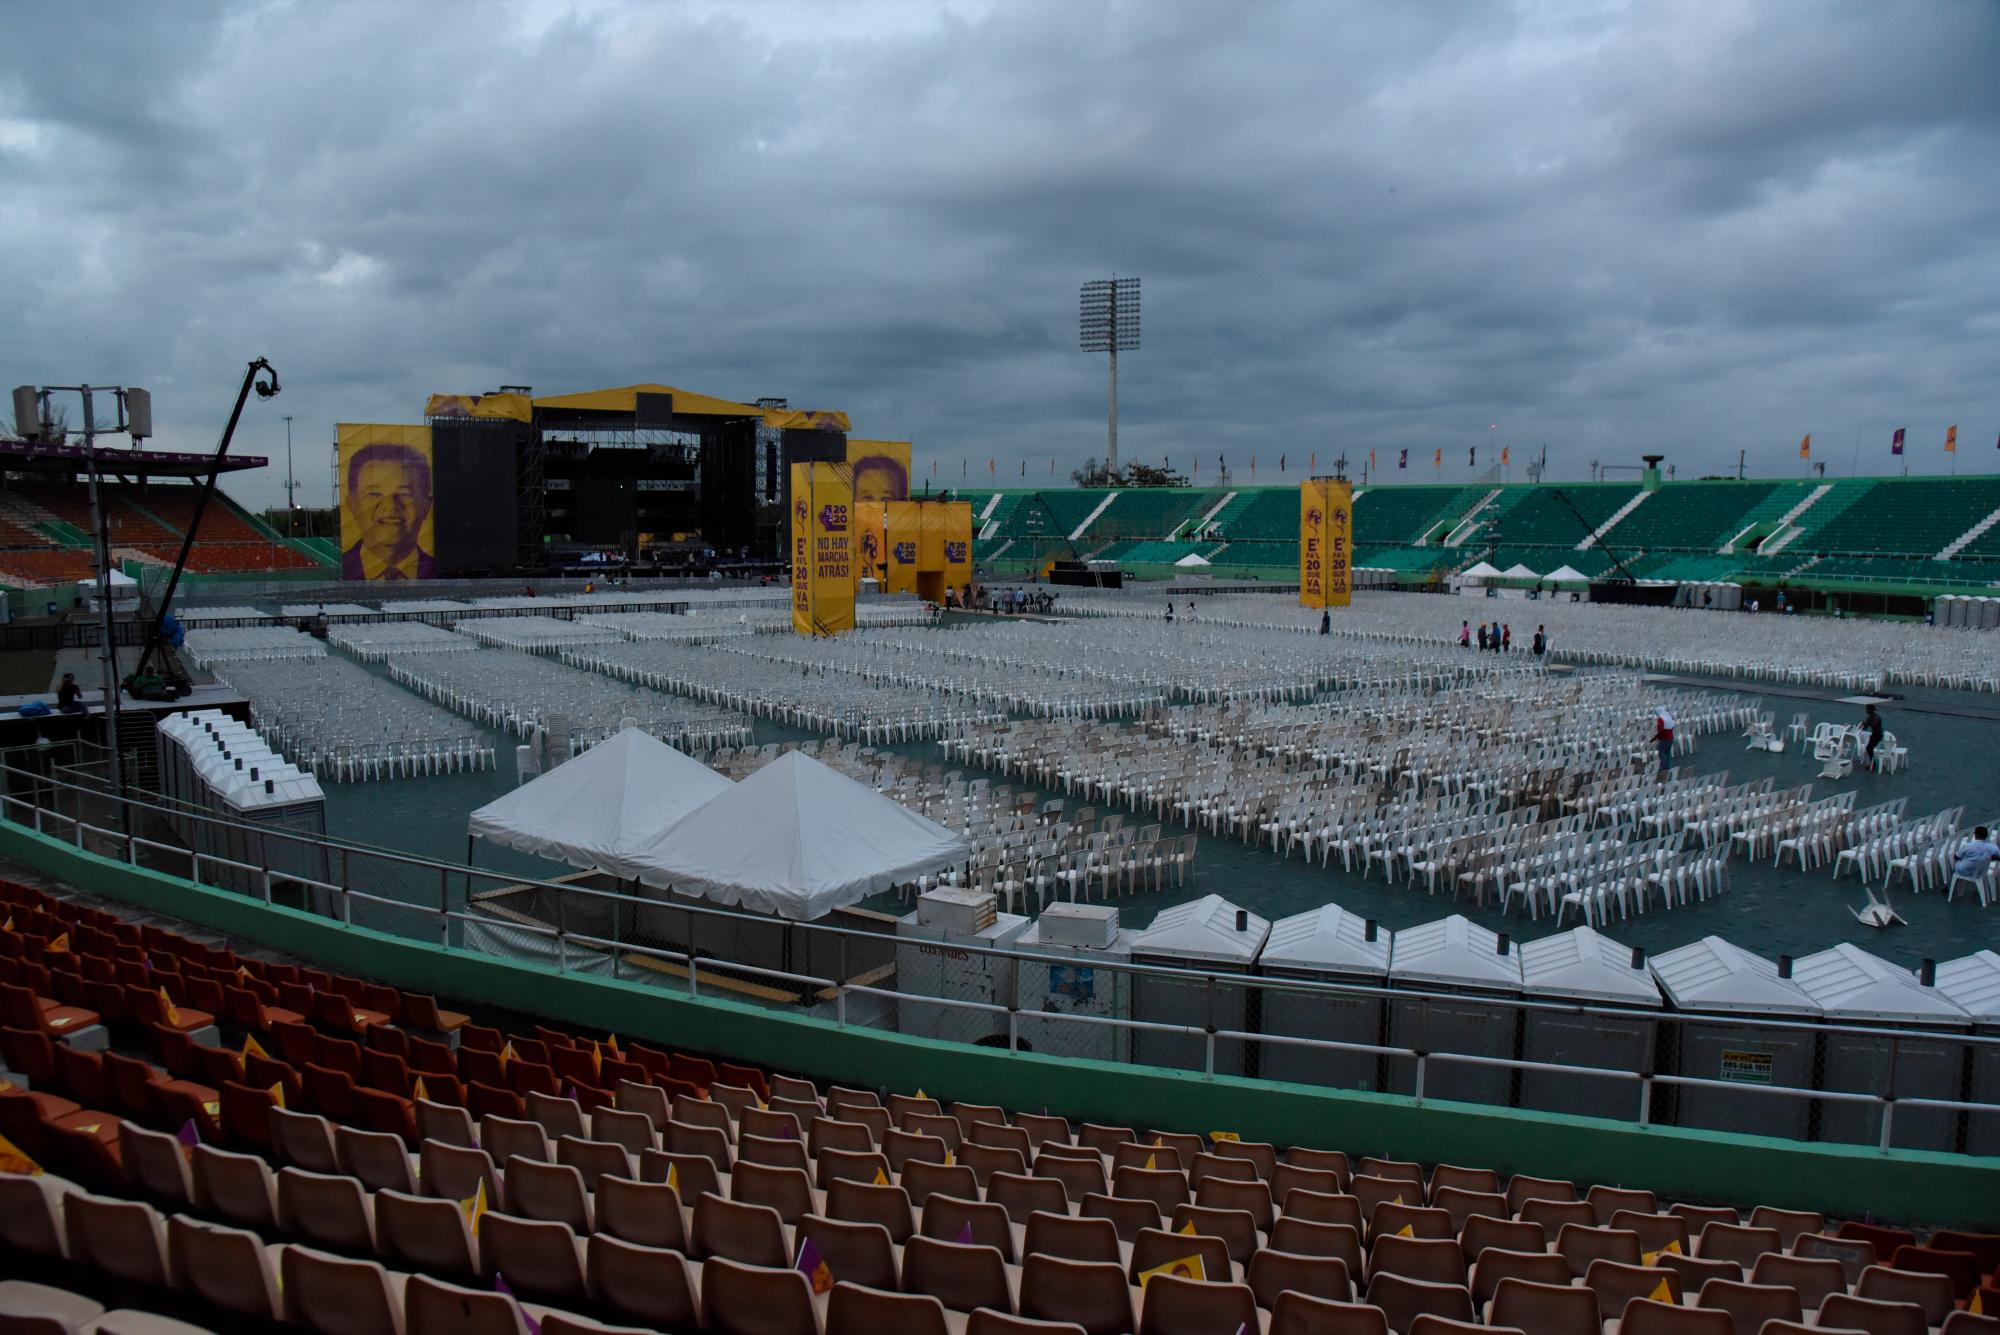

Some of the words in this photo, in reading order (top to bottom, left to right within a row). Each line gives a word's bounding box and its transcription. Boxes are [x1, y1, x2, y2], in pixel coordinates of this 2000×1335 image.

[833, 505, 847, 513] 20
[833, 514, 848, 523] 20
[817, 537, 829, 550] NO
[832, 537, 849, 550] HAY
[817, 551, 849, 562] MARCHA
[1306, 560, 1320, 570] 20
[1332, 560, 1345, 570] 20
[796, 567, 807, 580] 20
[1306, 579, 1320, 588] VA
[1333, 578, 1346, 587] VA
[796, 591, 808, 602] VA
